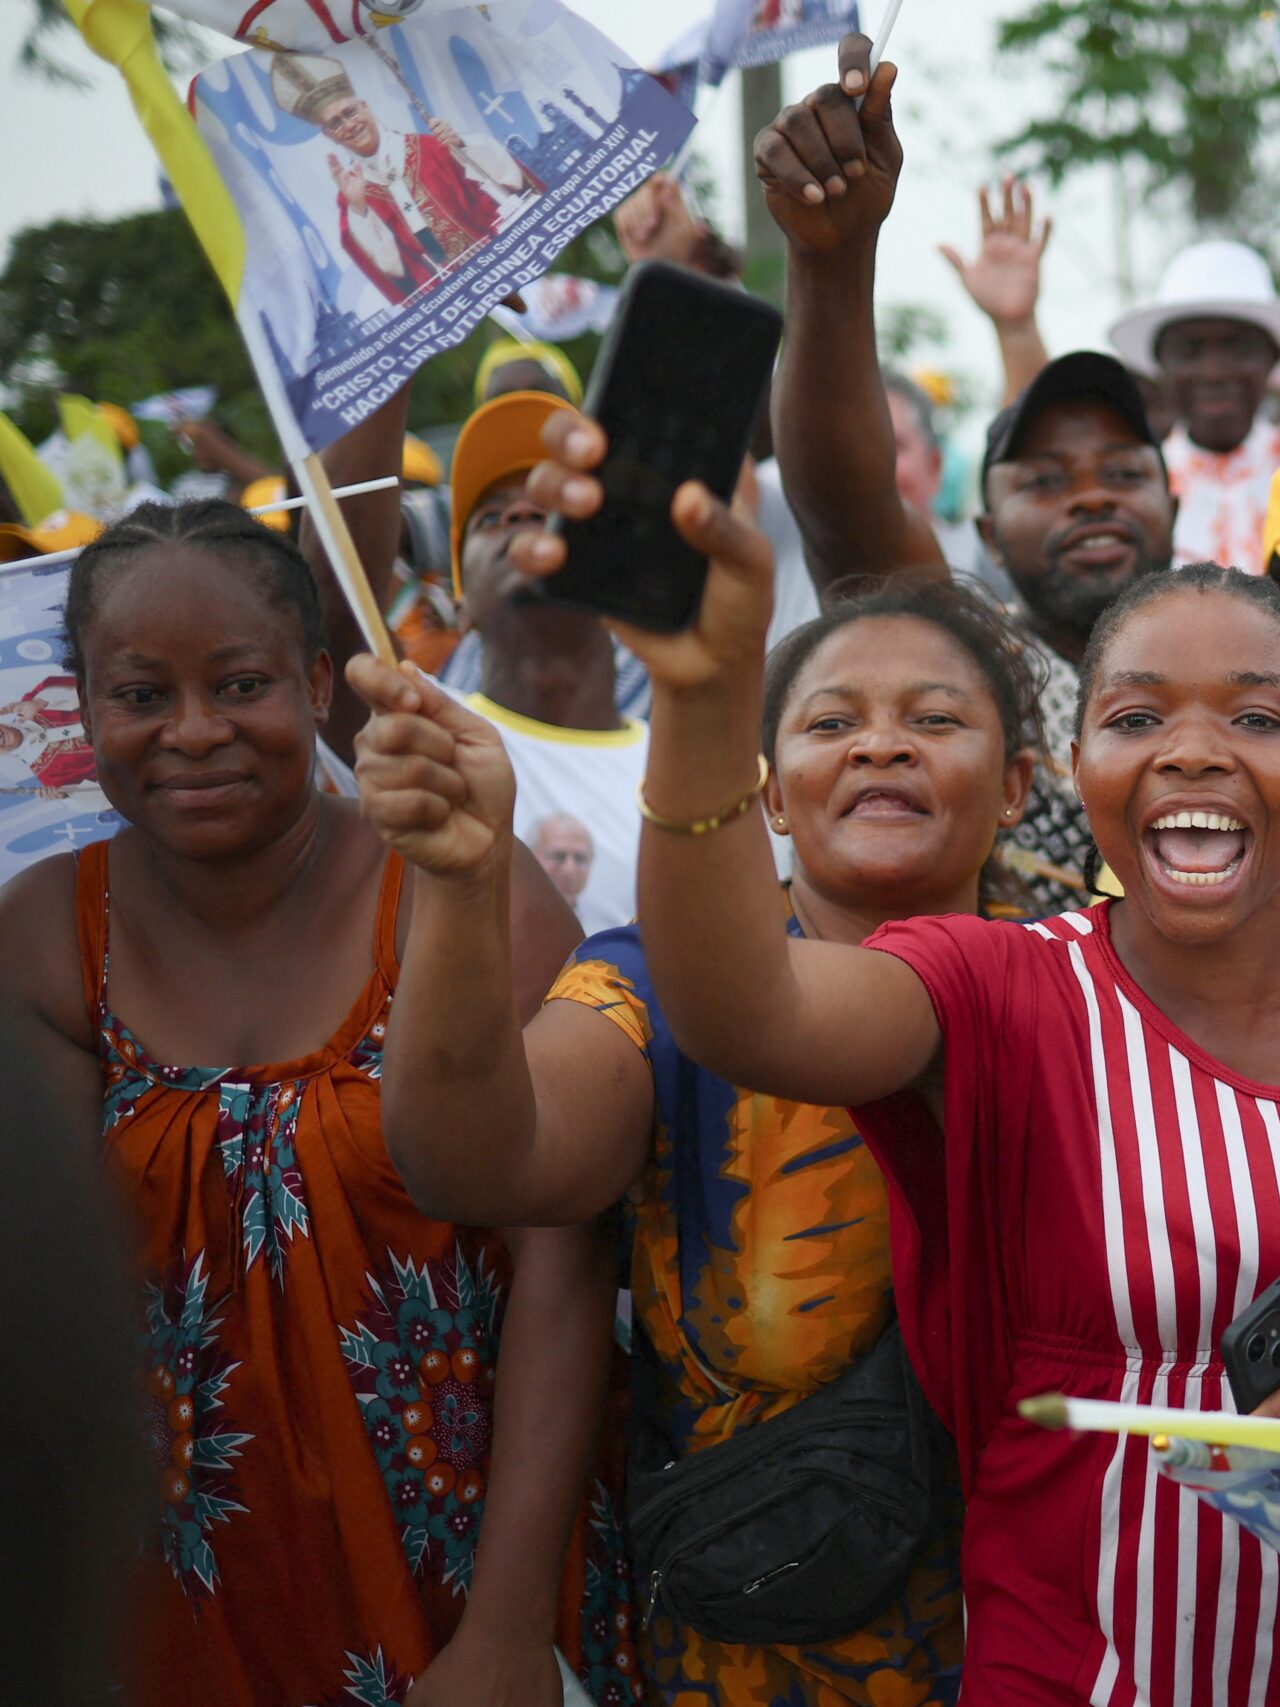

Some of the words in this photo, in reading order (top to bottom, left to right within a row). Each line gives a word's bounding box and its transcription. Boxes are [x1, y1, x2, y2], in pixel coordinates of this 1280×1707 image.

[340, 373, 408, 426] HACIA
[402, 344, 438, 369] UN
[434, 282, 513, 348] FUTURO
[512, 259, 547, 285] DE
[374, 341, 385, 351] a
[381, 312, 423, 344] Guinea
[420, 266, 482, 315] Ecuatorial,
[477, 252, 497, 268] Su
[493, 209, 544, 254] Santidad
[541, 198, 556, 212] el
[550, 174, 582, 201] Papa
[577, 147, 609, 176] León
[602, 124, 629, 150] XIV!
[400, 320, 444, 351] LUZ
[440, 294, 473, 323] DE
[470, 234, 546, 295] GUINEA
[542, 128, 659, 233] ECUATORIAL
